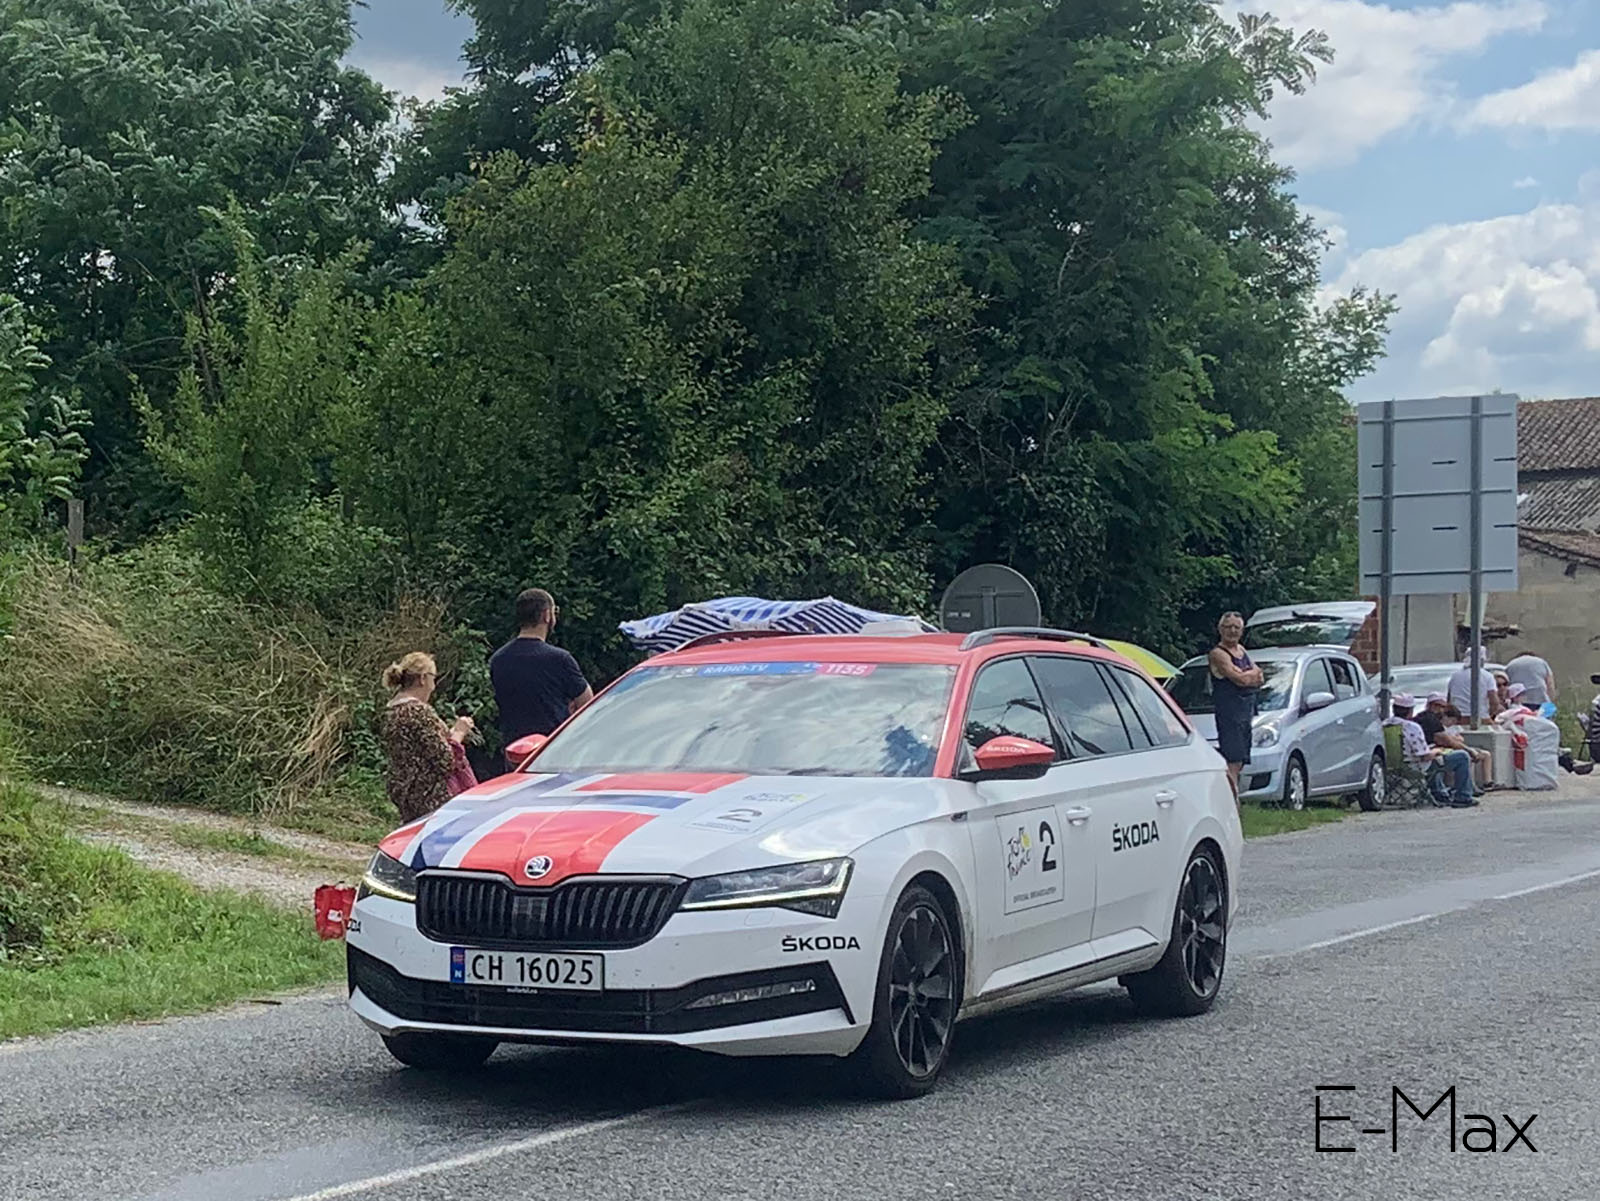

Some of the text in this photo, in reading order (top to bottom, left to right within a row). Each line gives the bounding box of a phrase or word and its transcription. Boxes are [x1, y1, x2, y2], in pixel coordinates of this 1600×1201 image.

[716, 808, 762, 823] 2
[1039, 820, 1057, 872] 2
[1112, 820, 1160, 852] ŠKODA
[781, 934, 861, 952] ŠKODA
[454, 969, 463, 979] N
[471, 954, 593, 985] CH 16025
